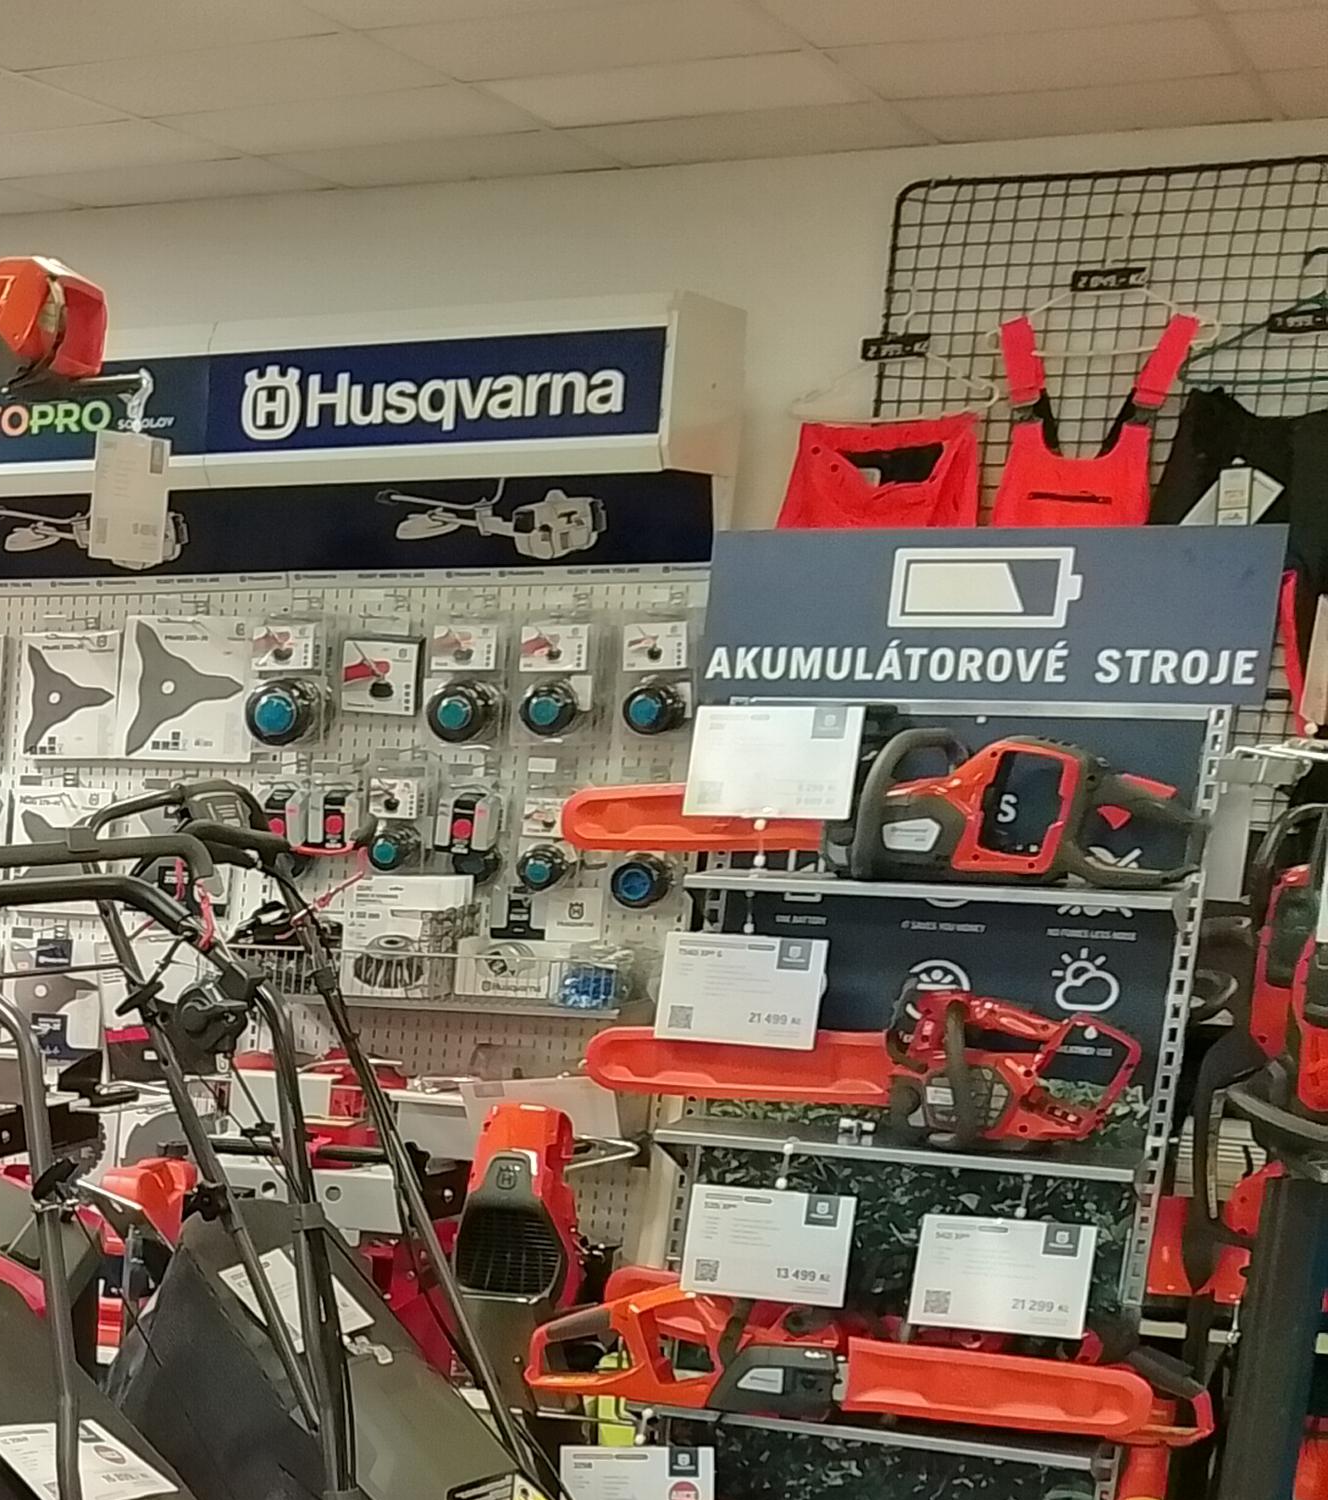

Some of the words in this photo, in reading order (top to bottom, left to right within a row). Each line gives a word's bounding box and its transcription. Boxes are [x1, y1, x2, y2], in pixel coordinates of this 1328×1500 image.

[305, 368, 625, 431] Husqvarna
[117, 416, 175, 430] SOOLOV
[705, 639, 1068, 684] AKUMULÁTOROVÉ
[1094, 648, 1259, 686] STROJE
[748, 1011, 761, 1024] 21
[764, 1013, 788, 1025] 499
[776, 1267, 789, 1279] 13
[791, 1269, 816, 1282] 499
[1011, 1297, 1025, 1310] 21
[1028, 1299, 1055, 1312] 299
